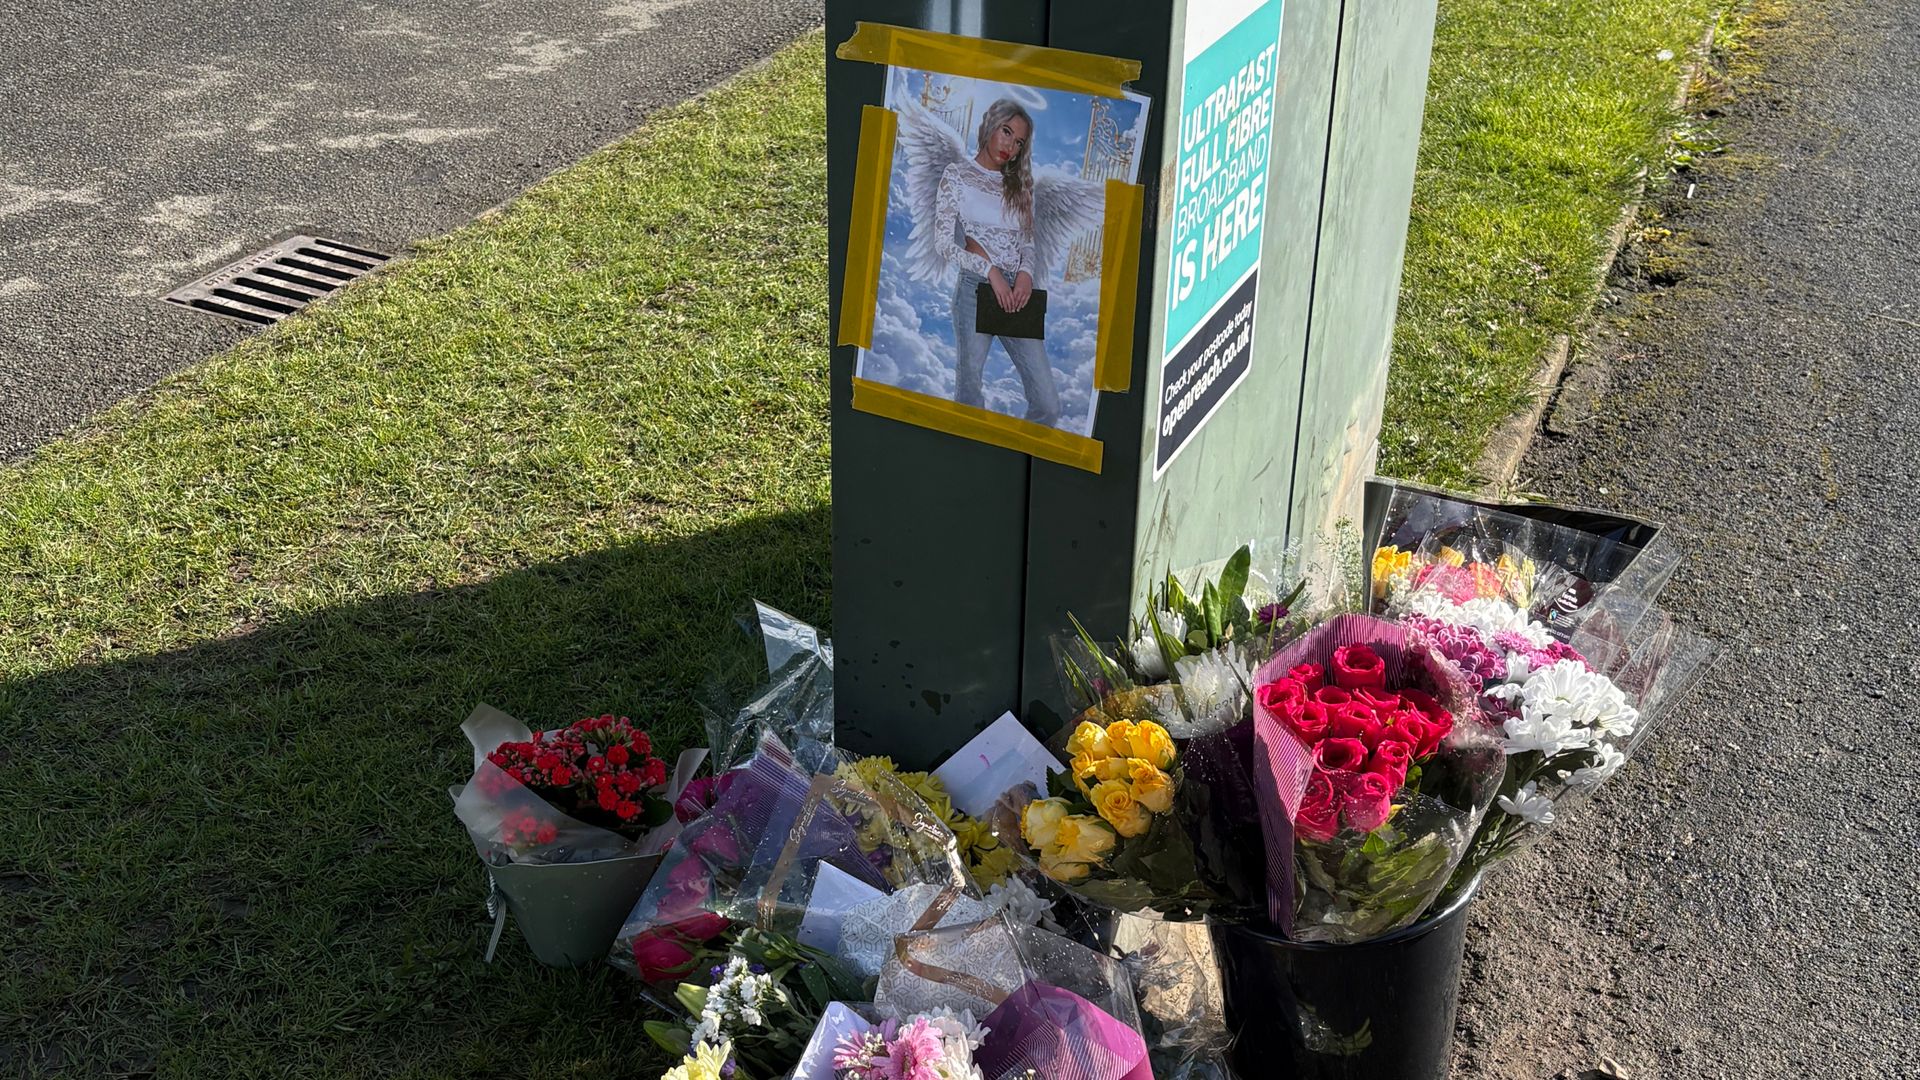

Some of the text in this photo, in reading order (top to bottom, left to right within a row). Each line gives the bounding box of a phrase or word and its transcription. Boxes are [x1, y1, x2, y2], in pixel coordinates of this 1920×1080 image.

[1179, 86, 1272, 204] FULL FIBRE
[1184, 42, 1276, 152] ULTRAFAST
[1172, 171, 1264, 312] IS HERE
[1176, 132, 1267, 245] BROADBAND
[1162, 321, 1251, 437] openreach.co.uk
[1165, 300, 1253, 405] Check your postcode today
[830, 779, 873, 801] Signature
